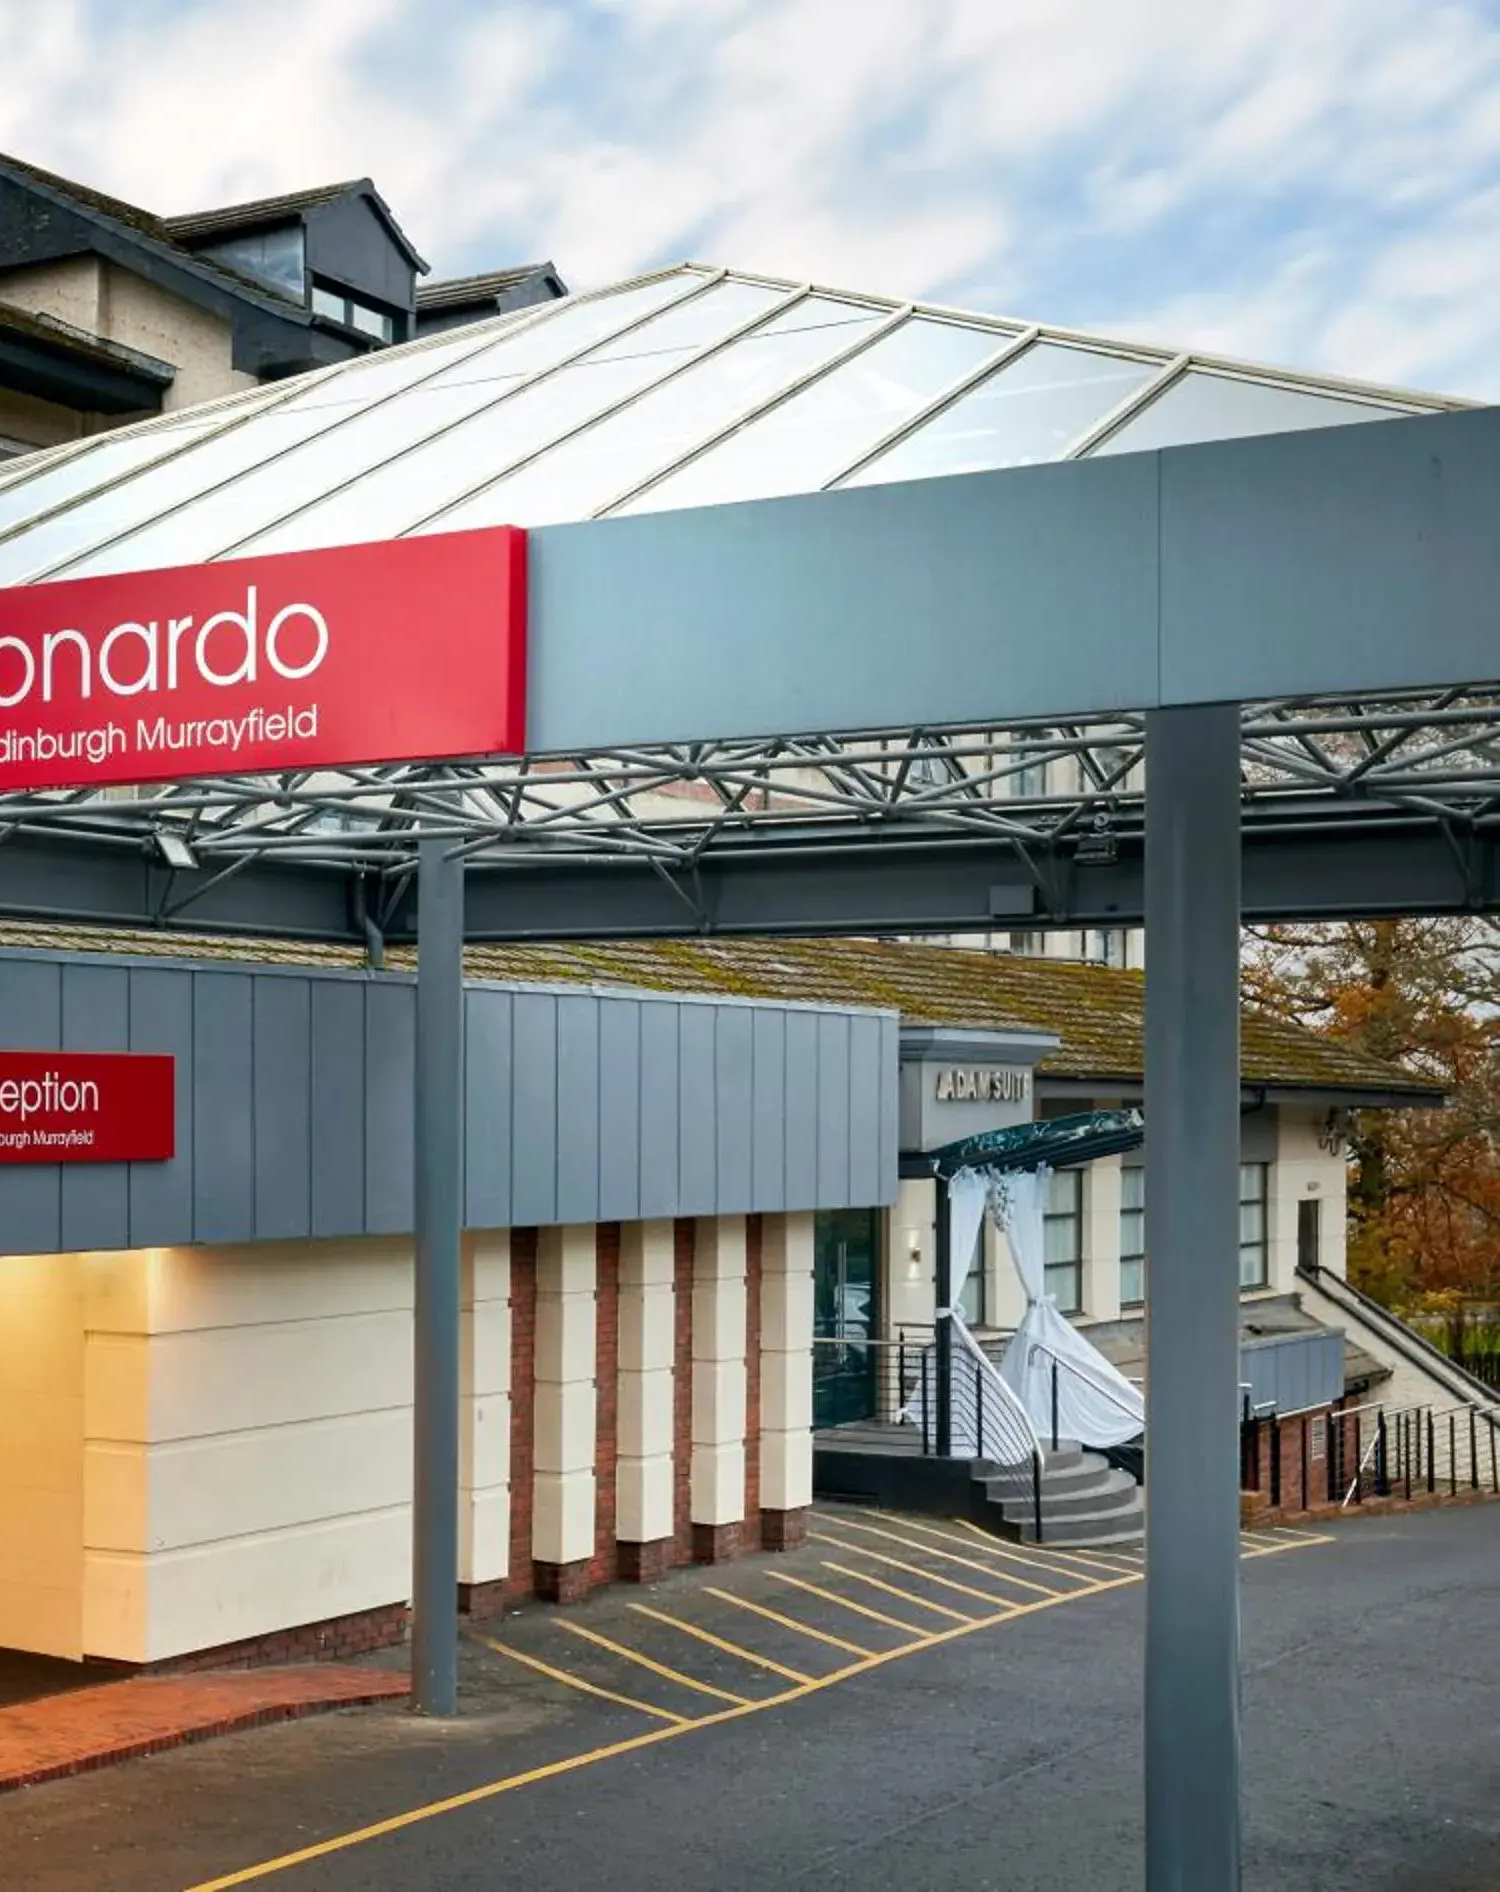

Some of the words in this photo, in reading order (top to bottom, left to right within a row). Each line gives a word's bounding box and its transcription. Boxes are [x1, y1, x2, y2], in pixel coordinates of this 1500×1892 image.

[137, 704, 318, 751] Murrayfield
[937, 1069, 991, 1101] ADAM
[993, 1071, 1029, 1101] SUITE
[33, 1129, 94, 1148] Murrayfield
